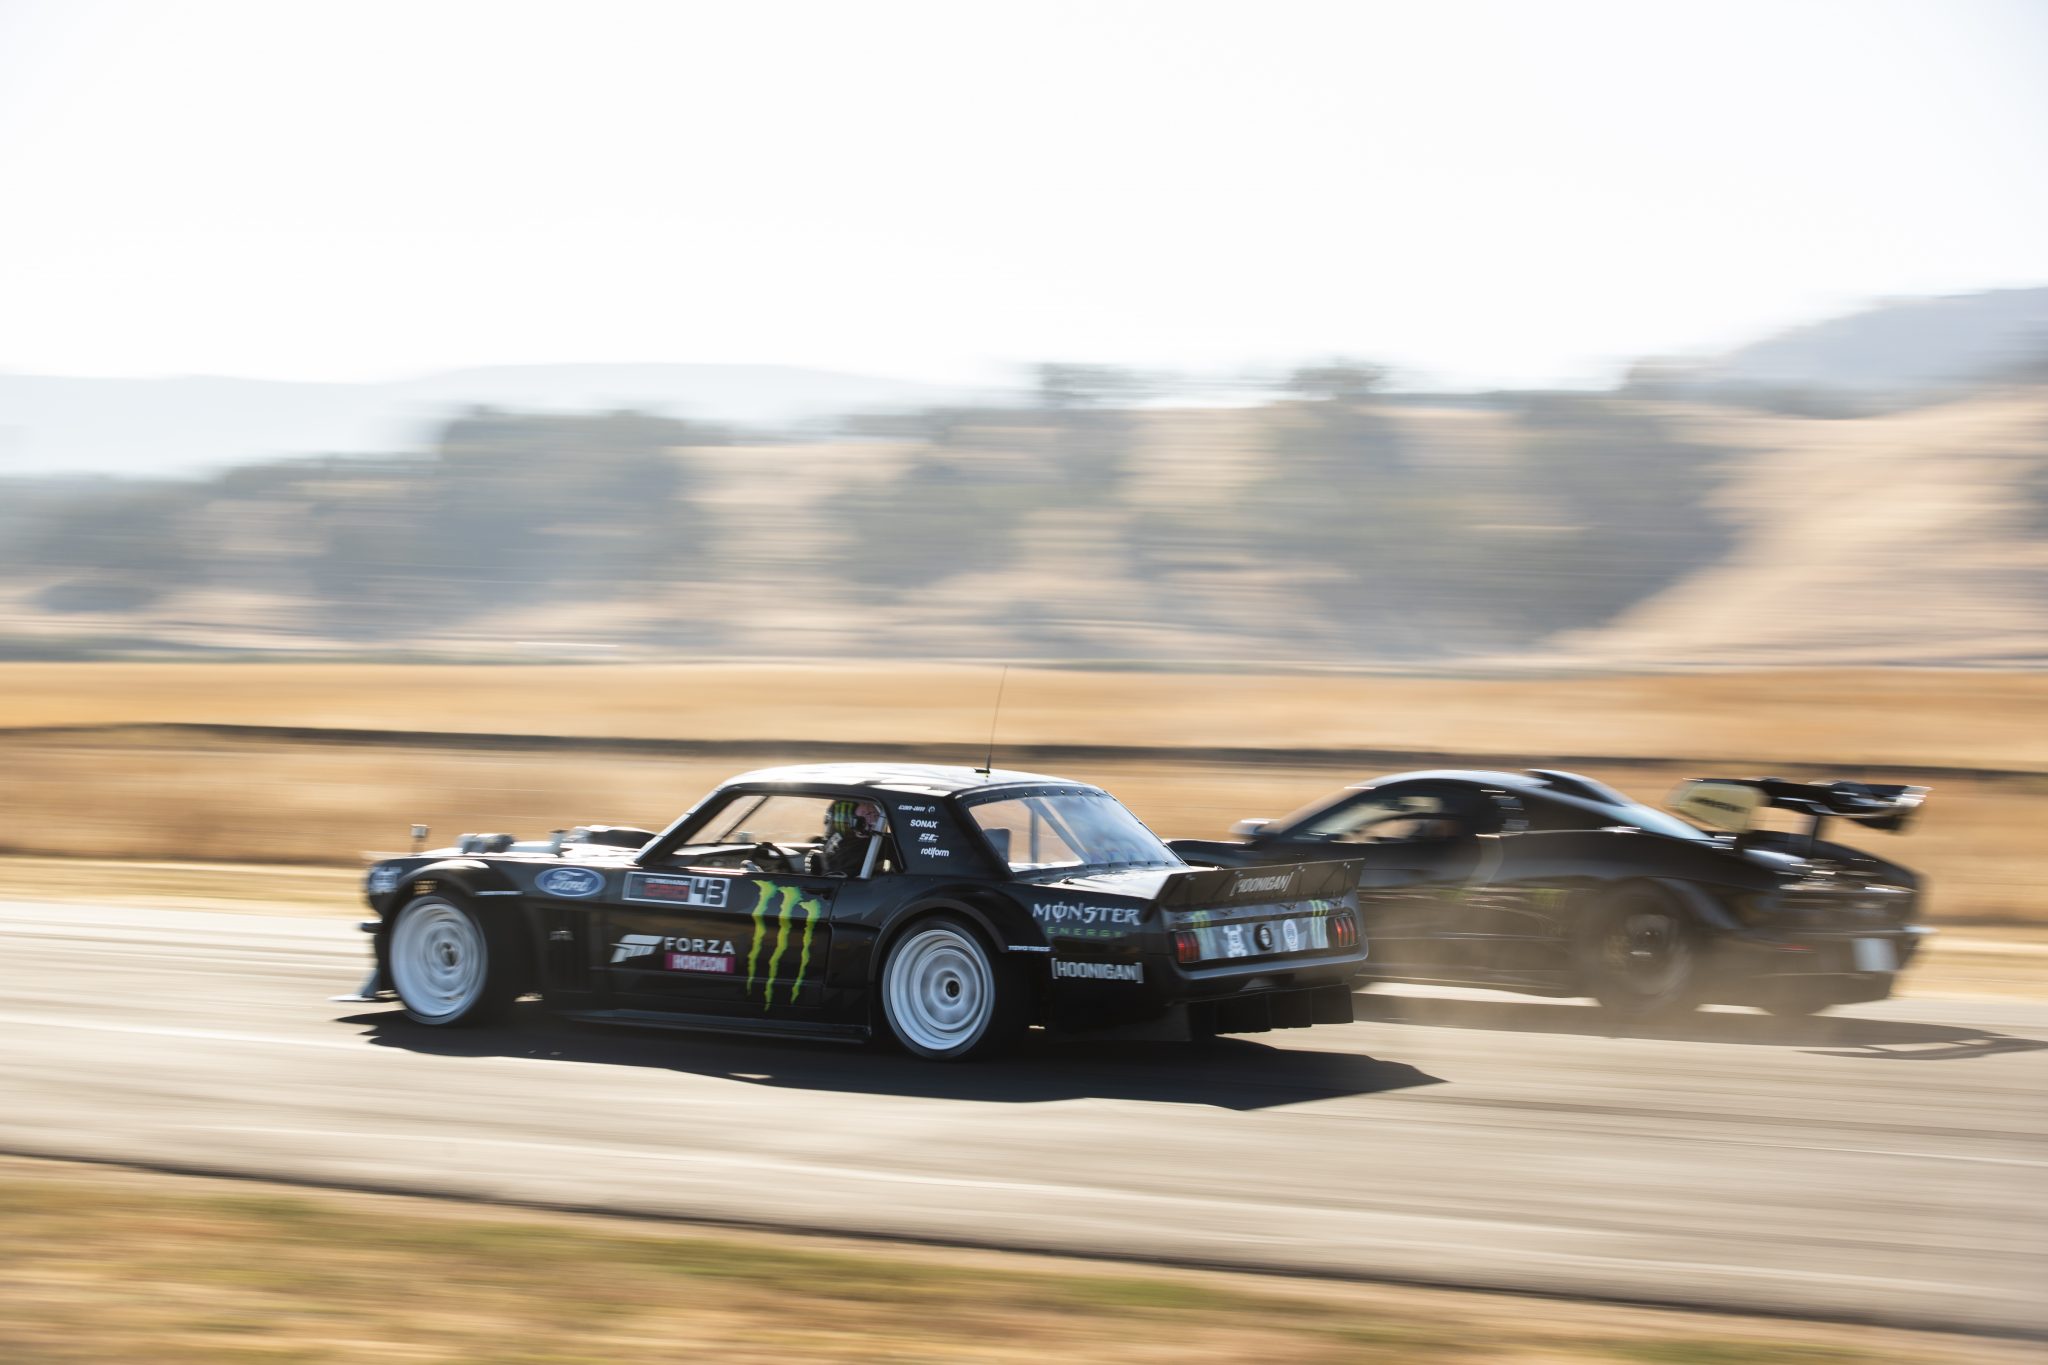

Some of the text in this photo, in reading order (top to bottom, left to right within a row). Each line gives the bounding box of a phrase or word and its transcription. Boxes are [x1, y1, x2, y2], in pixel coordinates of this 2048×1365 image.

[910, 819, 937, 829] SONAX
[921, 847, 949, 858] rotiform
[694, 879, 726, 904] 43
[664, 937, 736, 955] FORZA
[672, 954, 728, 972] HORIZON
